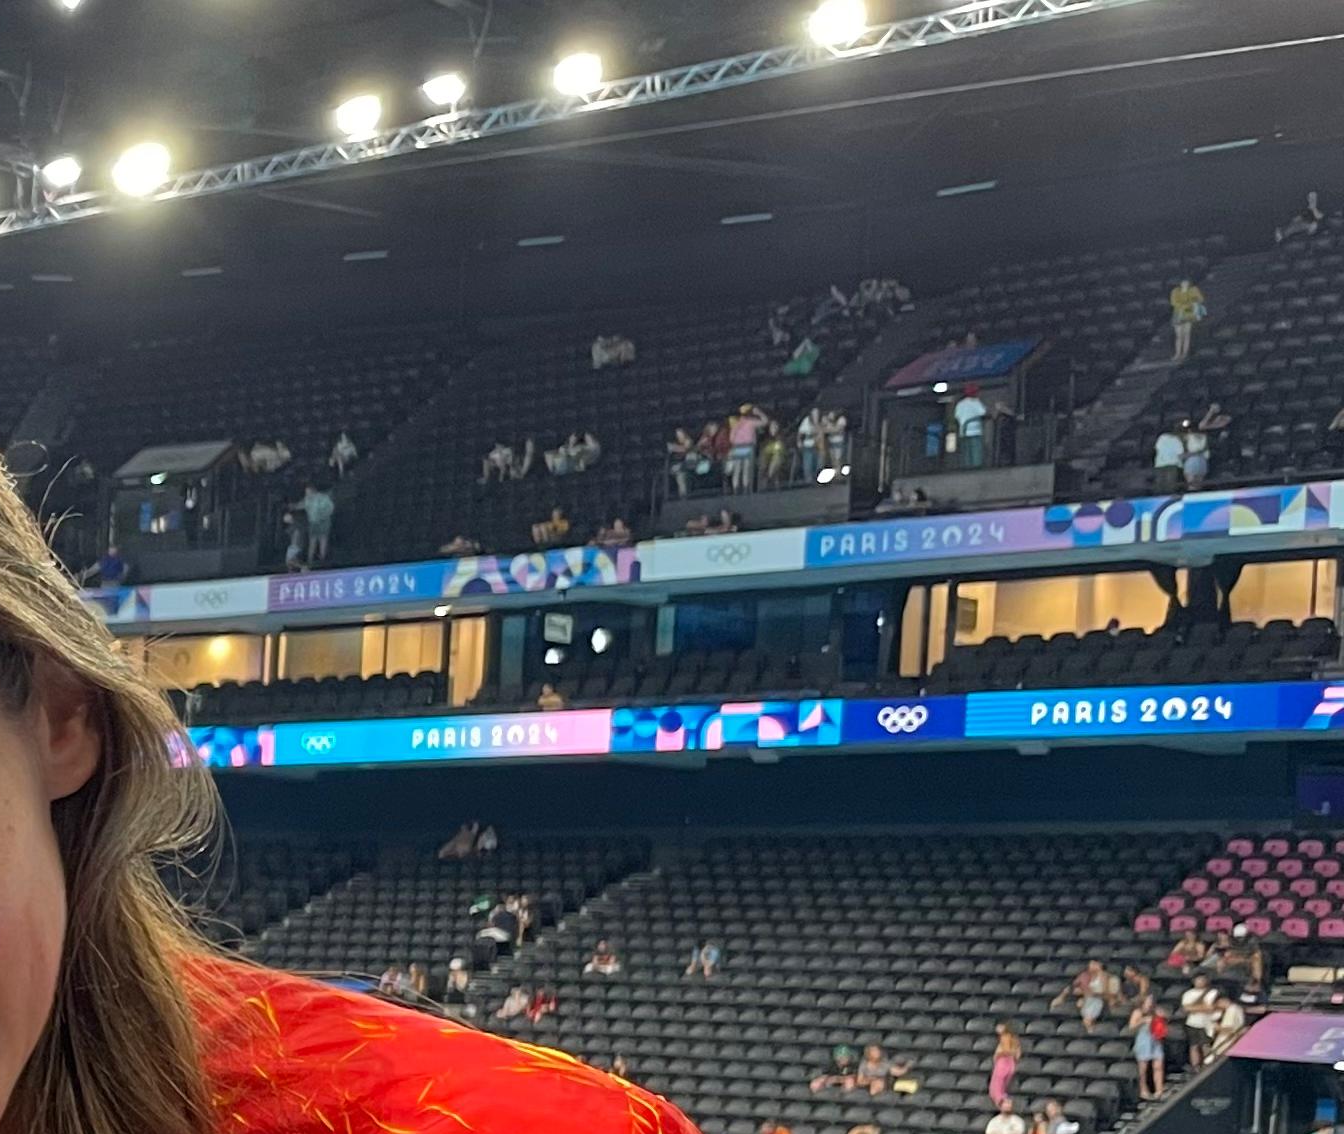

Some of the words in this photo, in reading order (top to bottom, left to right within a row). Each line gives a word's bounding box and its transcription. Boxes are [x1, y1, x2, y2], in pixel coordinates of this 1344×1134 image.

[820, 528, 909, 557] PARIS
[921, 522, 1004, 549] 2024
[279, 578, 344, 604] PARIS
[354, 572, 416, 597] 2024
[1030, 698, 1128, 725] PARIS
[1140, 696, 1233, 722] 2024
[412, 726, 481, 749] PARIS
[491, 722, 559, 747] 2024
